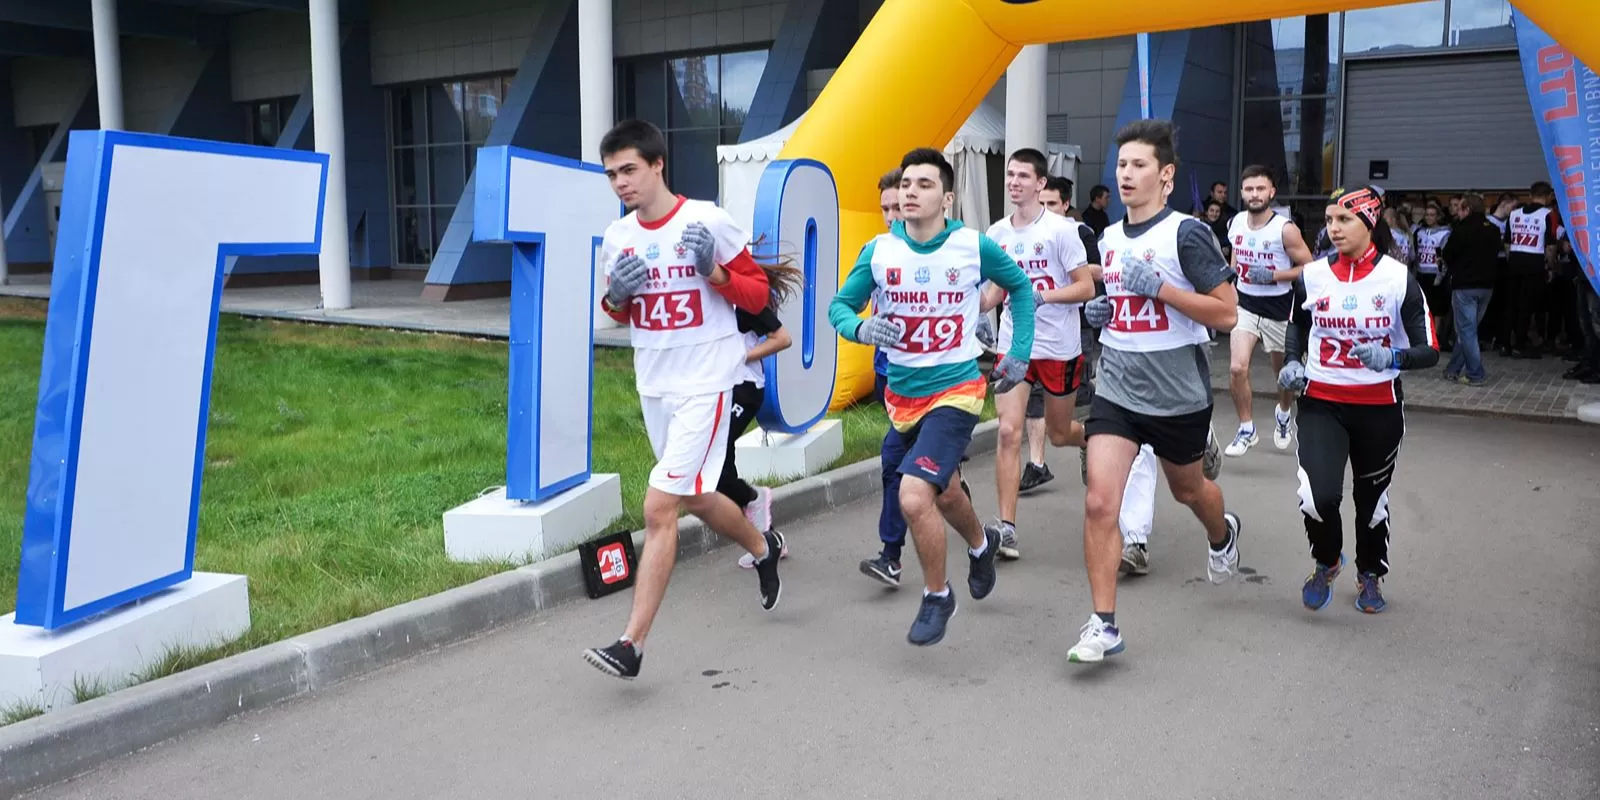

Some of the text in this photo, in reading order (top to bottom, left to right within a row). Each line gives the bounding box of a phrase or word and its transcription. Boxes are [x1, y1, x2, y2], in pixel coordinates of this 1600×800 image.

[1514, 233, 1536, 246] 177
[1257, 251, 1274, 260] ГТО
[1029, 259, 1048, 268] ГТО
[667, 265, 696, 279] ГТО
[885, 290, 964, 305] ГОНКА ГТО
[632, 293, 695, 328] 243
[1314, 315, 1391, 329] ГОНКА ГТО
